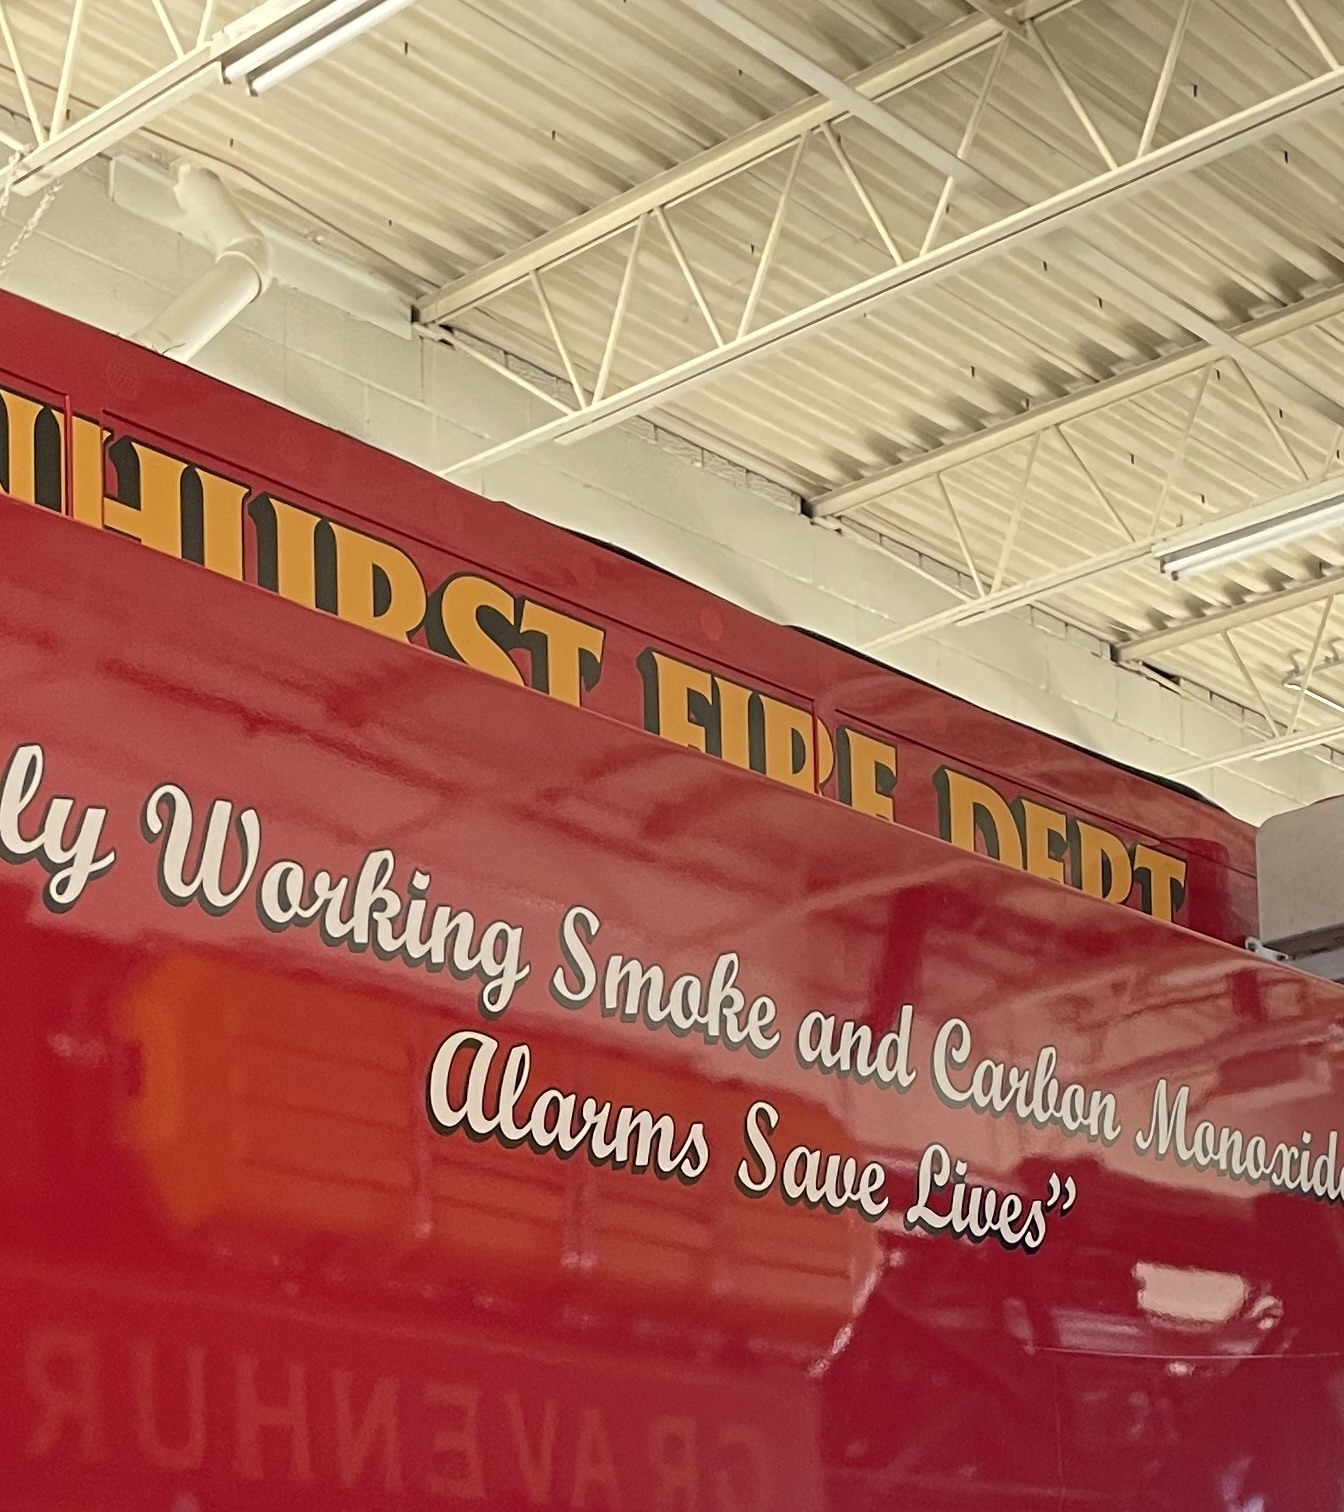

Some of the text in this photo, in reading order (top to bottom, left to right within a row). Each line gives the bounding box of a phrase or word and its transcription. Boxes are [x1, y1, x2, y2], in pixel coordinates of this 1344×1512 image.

[141, 784, 530, 1016] Working
[551, 907, 782, 1053] Smoke
[795, 1004, 918, 1092] and
[931, 1018, 1121, 1143] Carbon
[428, 1030, 710, 1181] Alarms
[738, 1103, 890, 1218] Save
